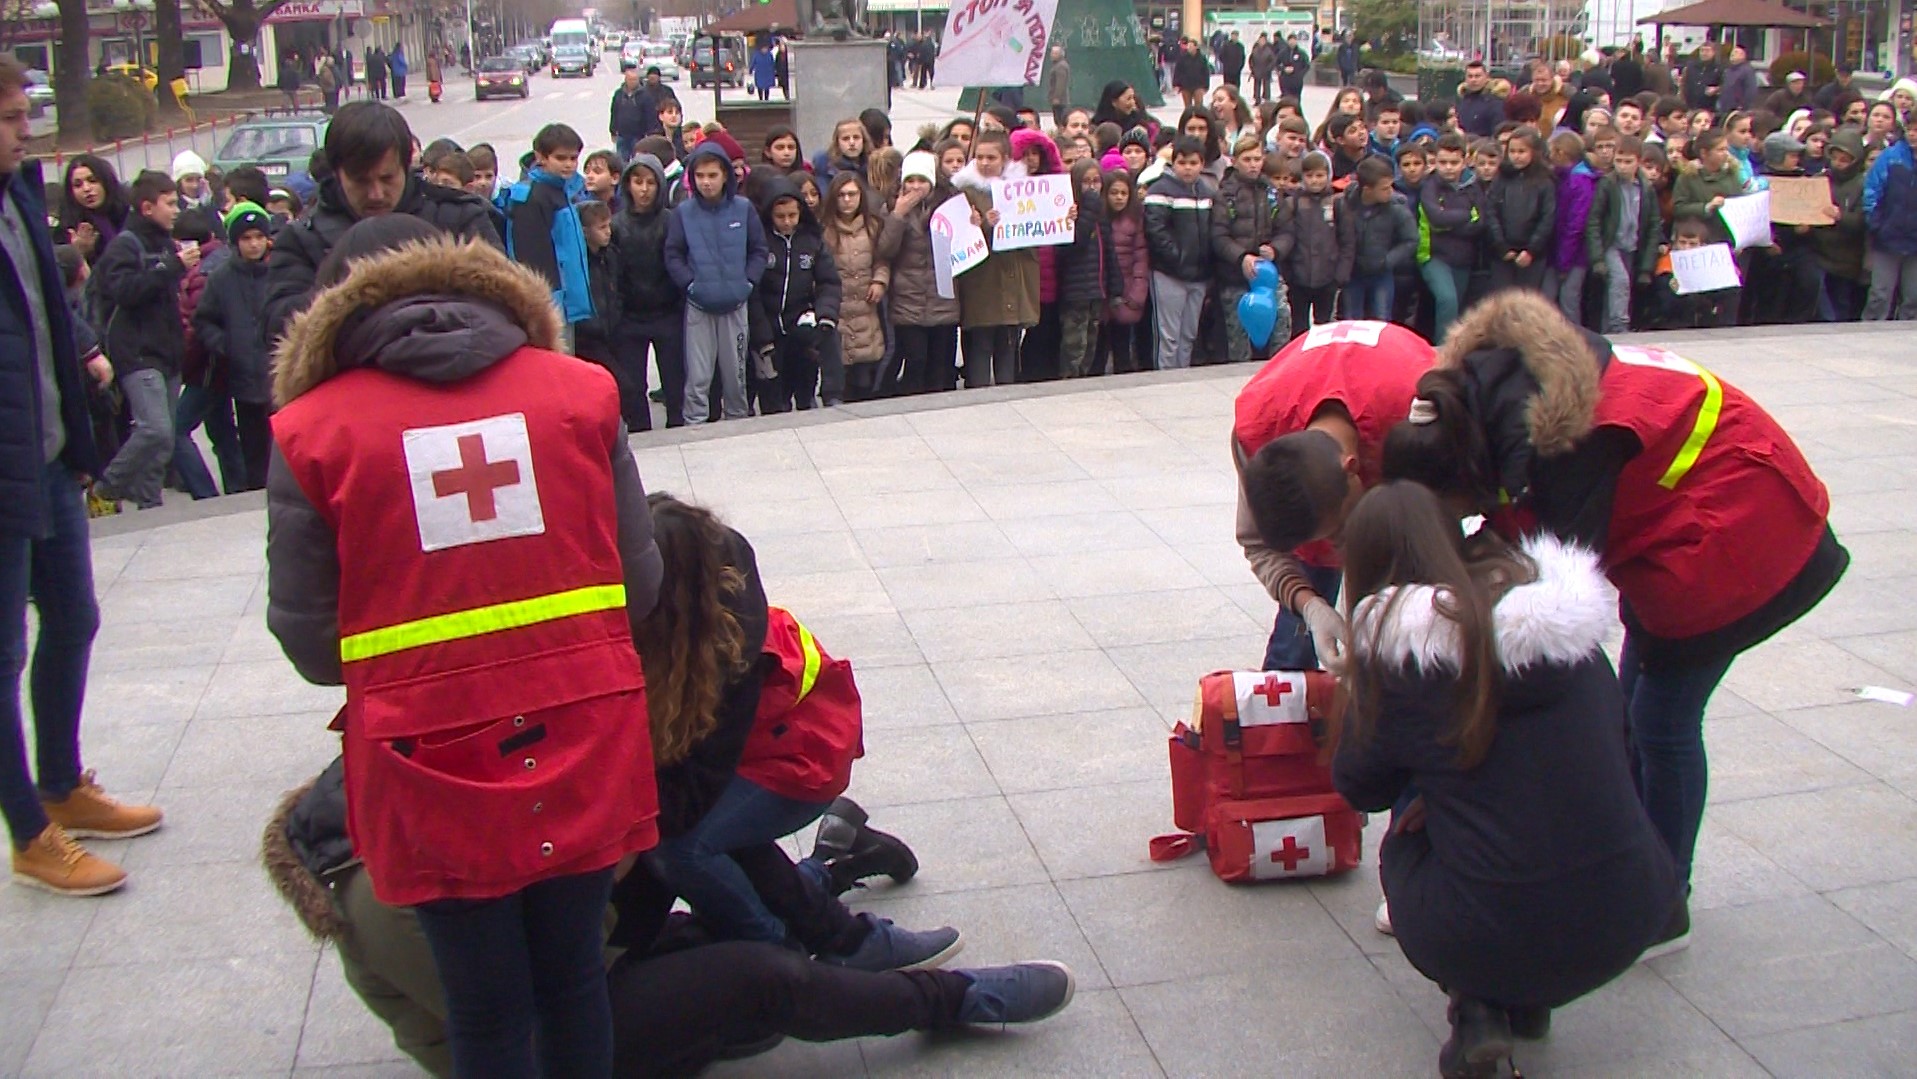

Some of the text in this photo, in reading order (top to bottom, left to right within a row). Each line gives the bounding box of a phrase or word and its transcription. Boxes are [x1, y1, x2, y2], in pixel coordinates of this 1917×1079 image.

[1004, 179, 1050, 200] СТОП
[1016, 199, 1037, 215] ЗА
[997, 215, 1073, 240] ПЕТАРДИТЕ
